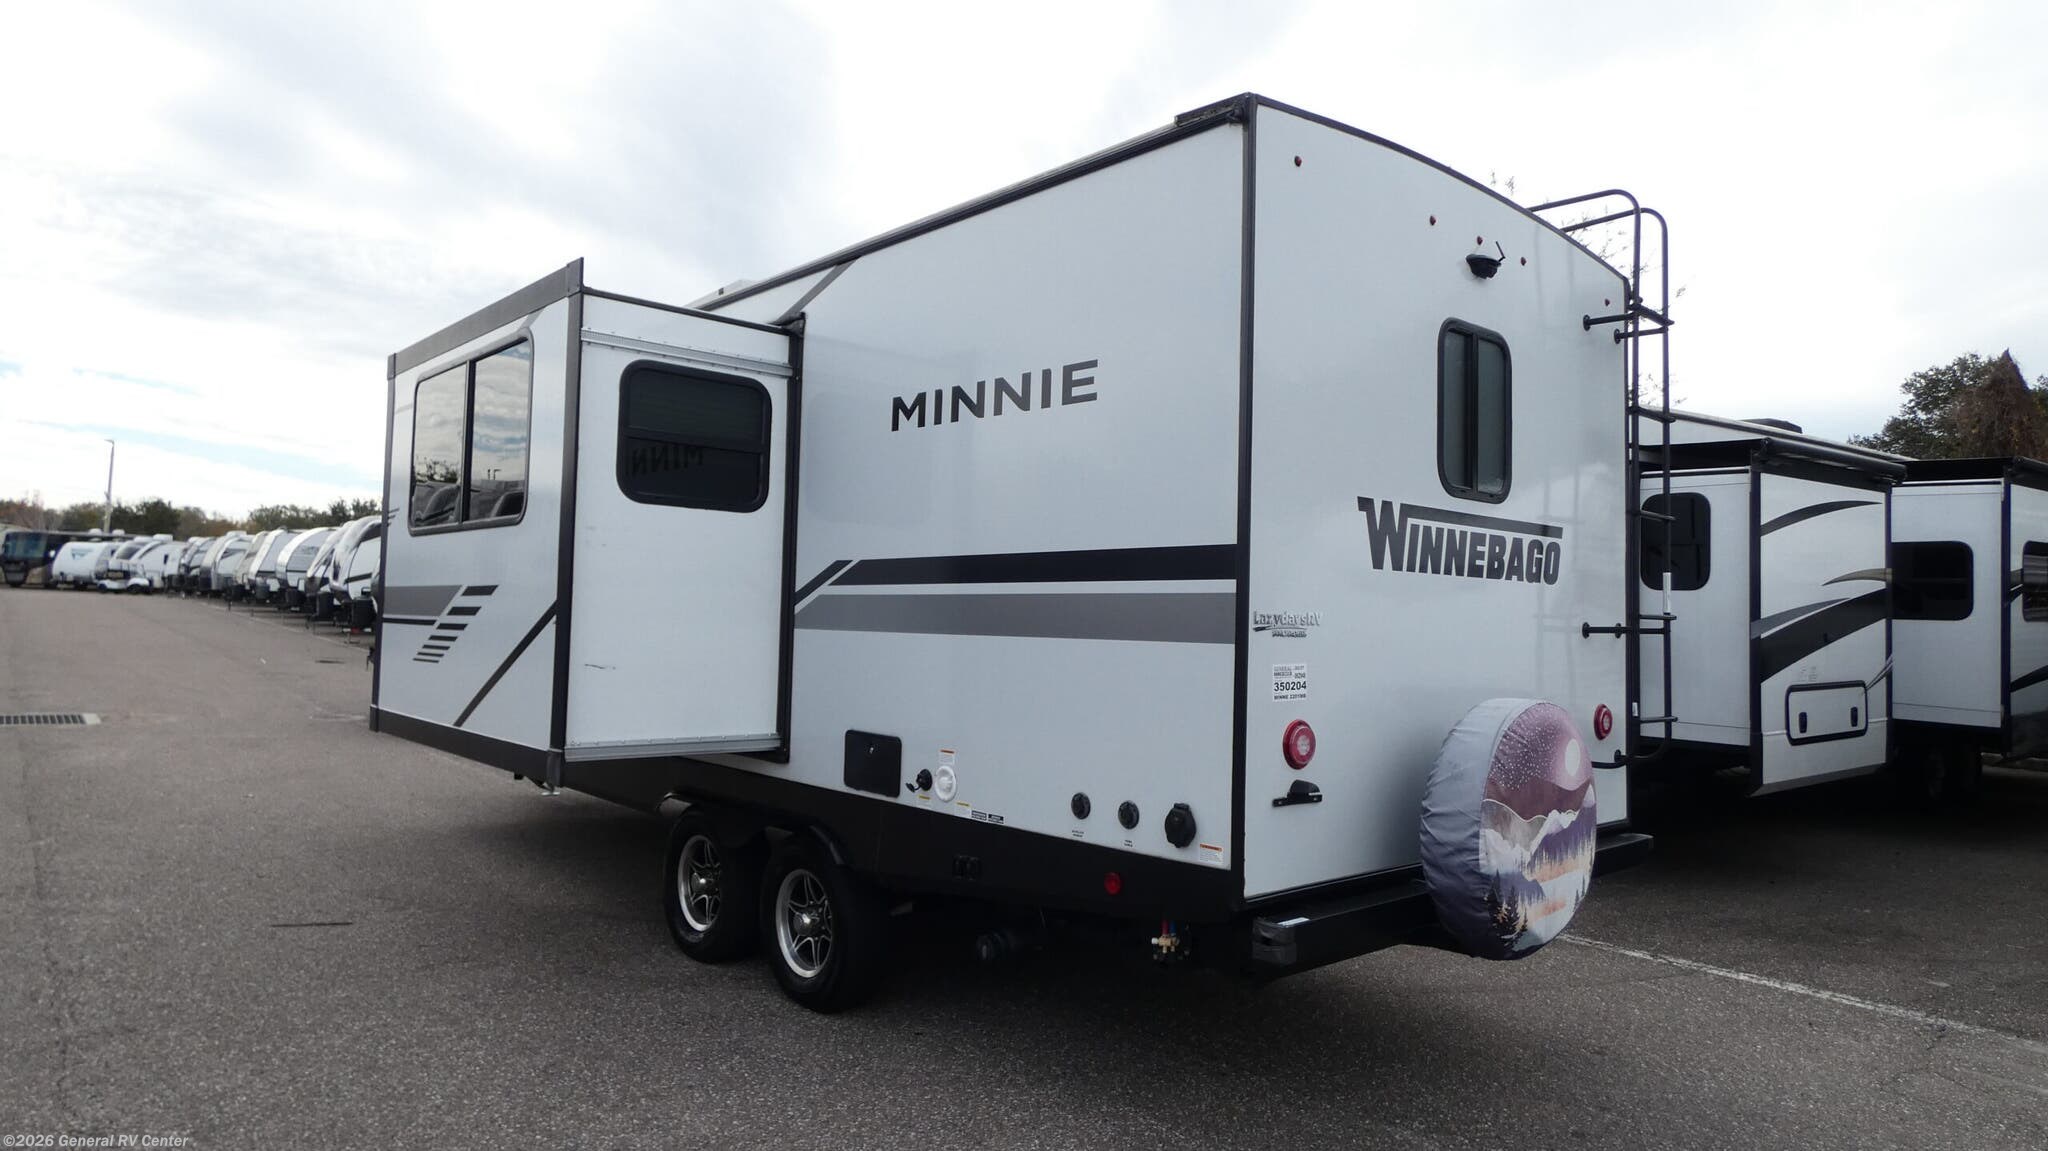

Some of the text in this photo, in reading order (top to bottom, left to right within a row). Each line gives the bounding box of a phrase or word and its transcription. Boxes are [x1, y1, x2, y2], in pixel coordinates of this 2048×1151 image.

[891, 359, 1098, 432] MINNIE
[1357, 496, 1563, 585] WINNEBAGO
[1274, 681, 1307, 692] 350204
